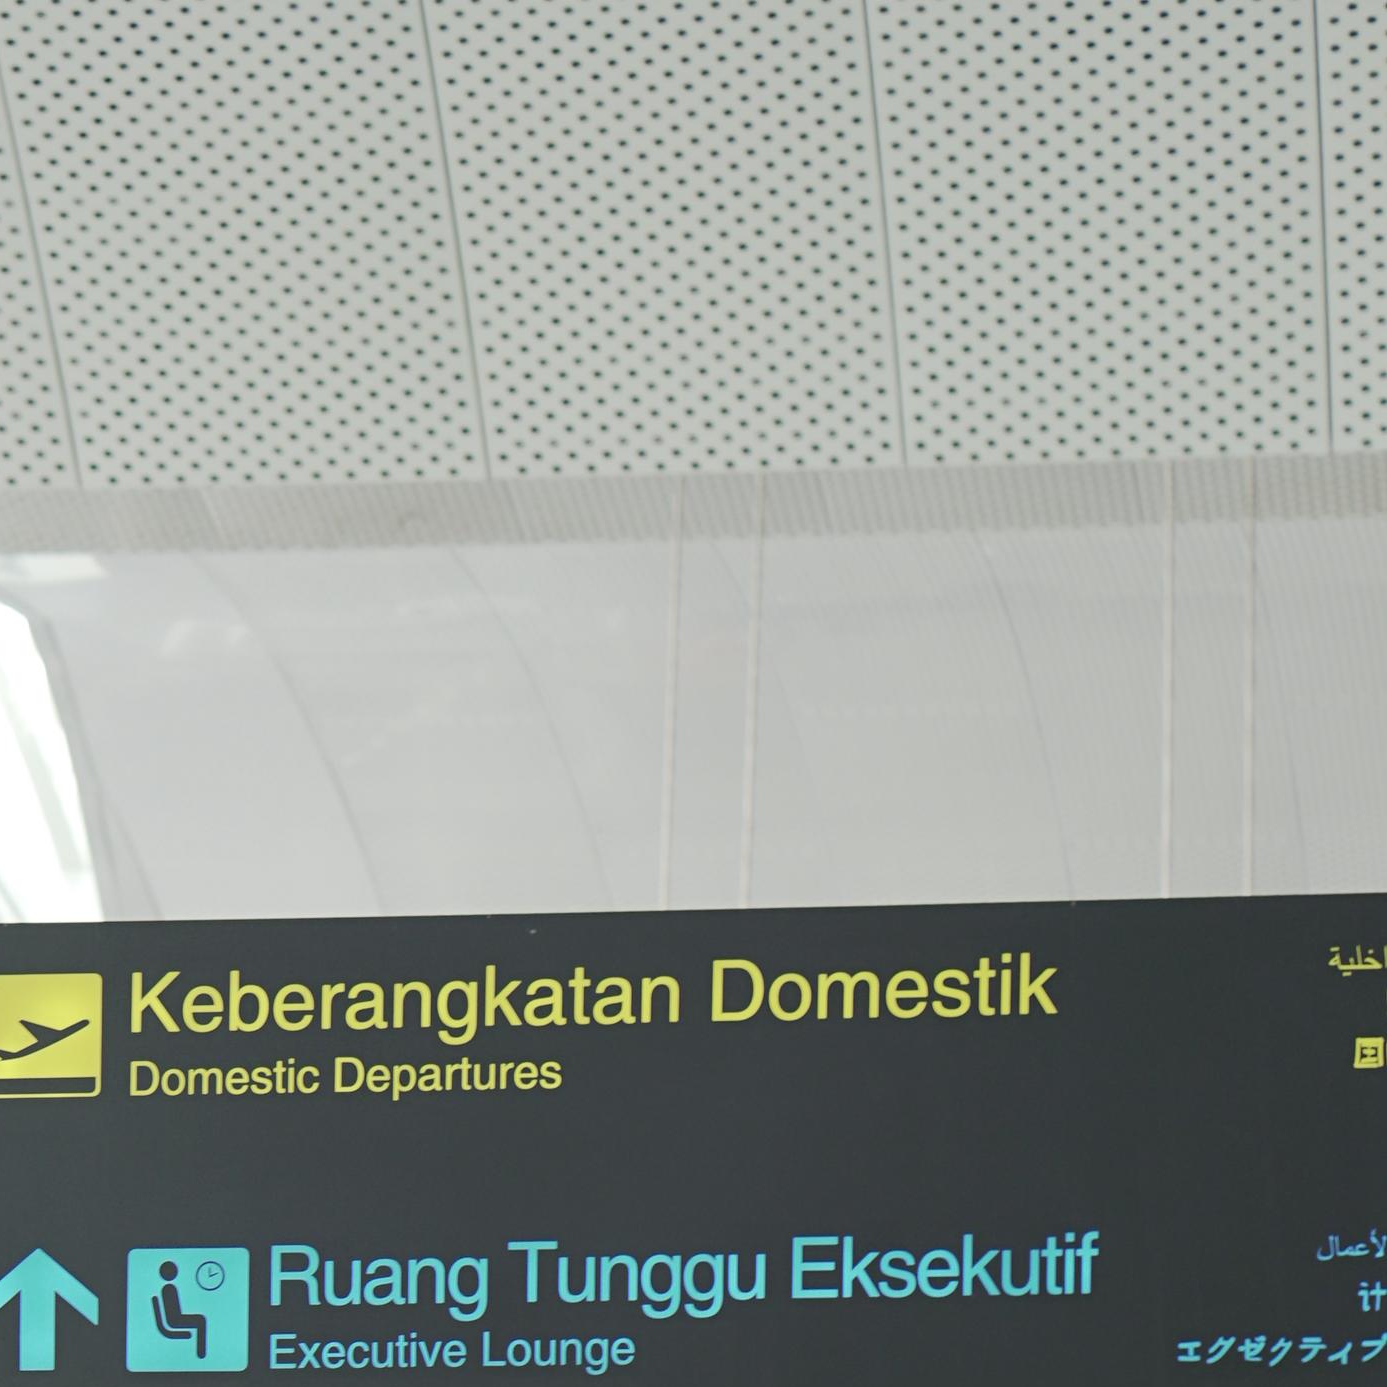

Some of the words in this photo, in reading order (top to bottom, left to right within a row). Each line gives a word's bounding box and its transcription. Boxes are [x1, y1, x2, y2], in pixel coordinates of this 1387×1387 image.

[130, 964, 680, 1046] Keberangkatan
[711, 952, 1058, 1022] Domestik
[129, 1058, 320, 1097] Domestic
[333, 1056, 563, 1102] Departures
[270, 1244, 489, 1322] Ruang
[507, 1240, 766, 1321] Tunggu
[791, 1230, 1100, 1300] Eksekutif
[269, 1332, 467, 1370] Executive
[482, 1331, 636, 1376] Lounge
